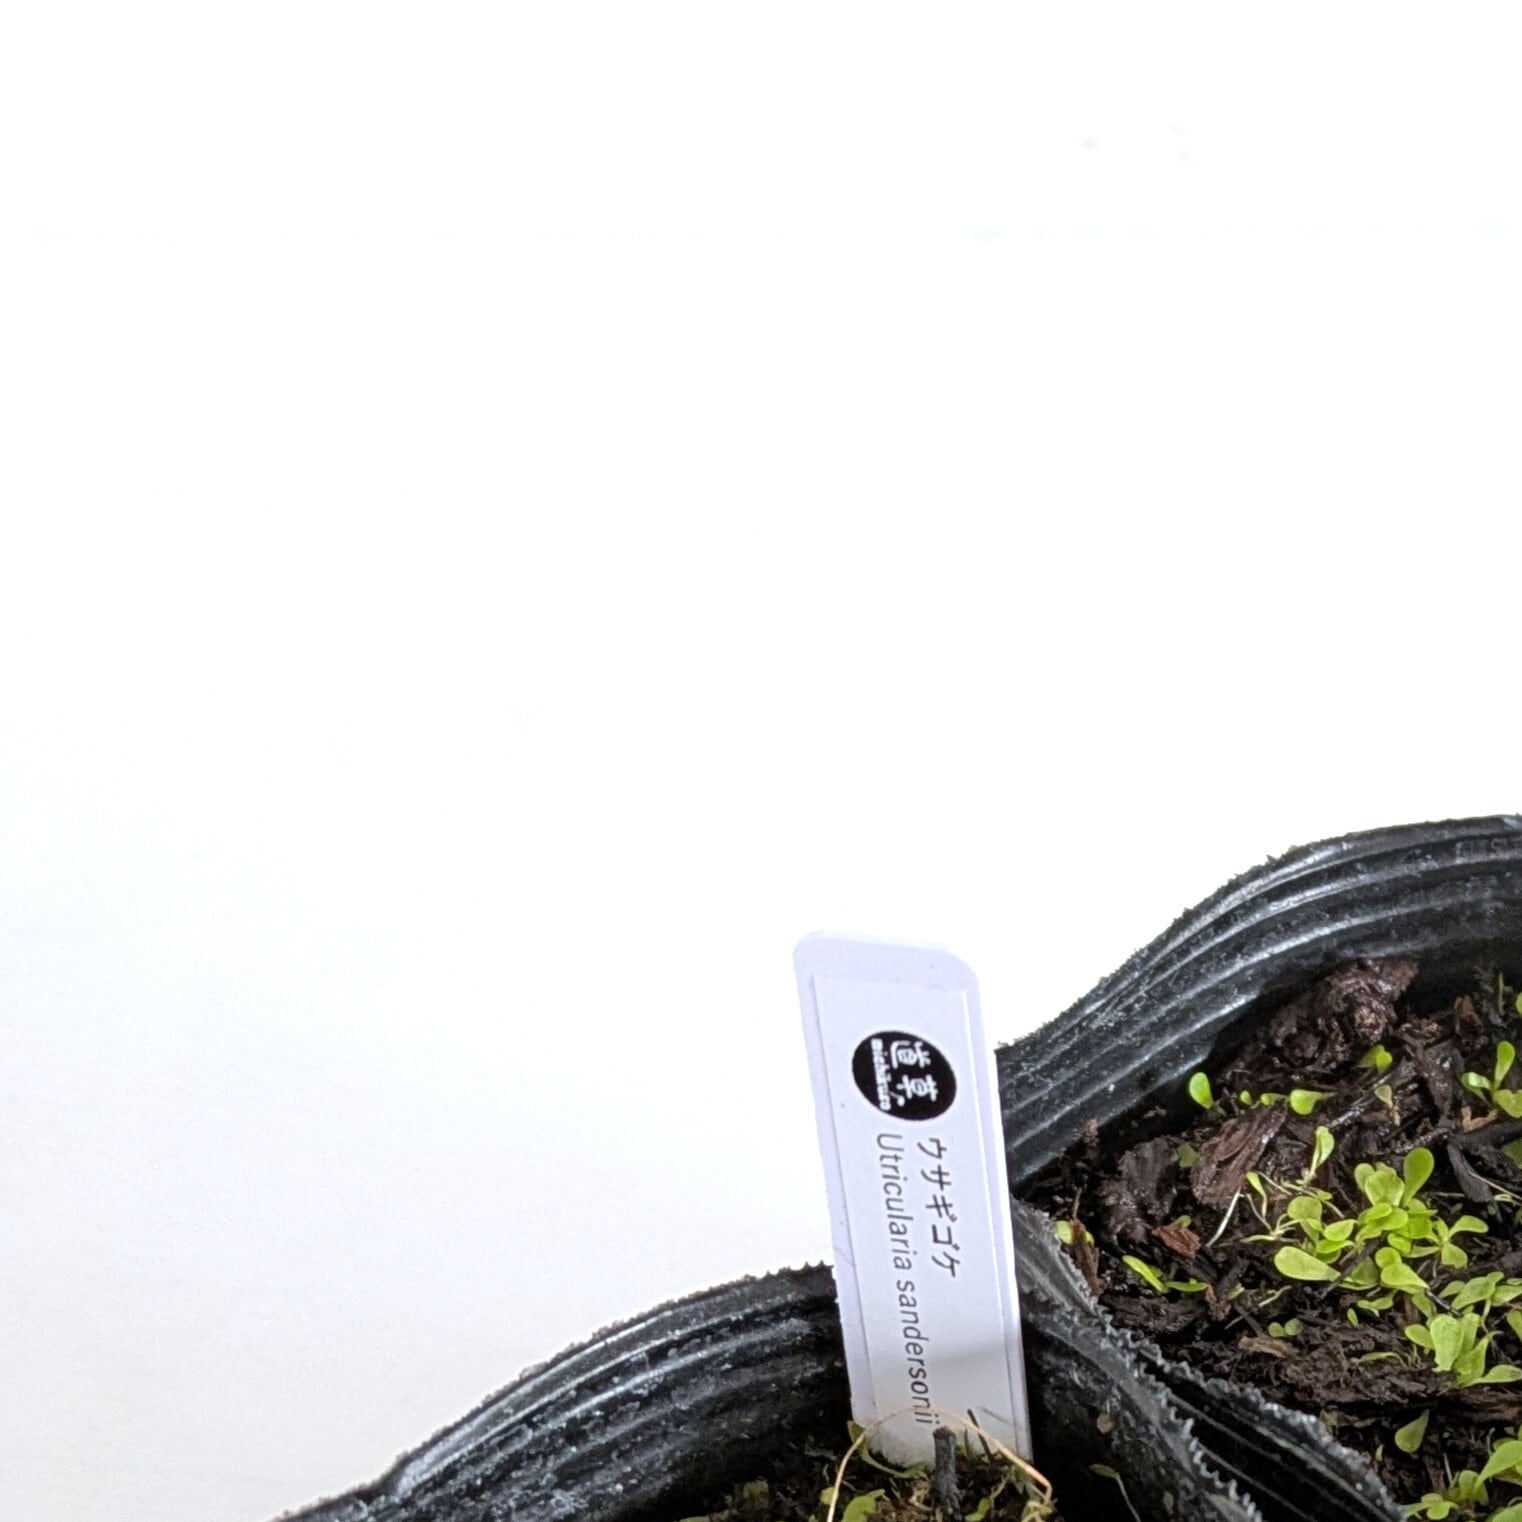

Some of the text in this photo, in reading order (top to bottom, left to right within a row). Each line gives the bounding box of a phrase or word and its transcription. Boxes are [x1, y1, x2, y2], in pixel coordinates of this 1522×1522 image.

[876, 1132, 941, 1426] Utricularia sandersonii
[916, 1137, 961, 1280] ウサギゴケ
